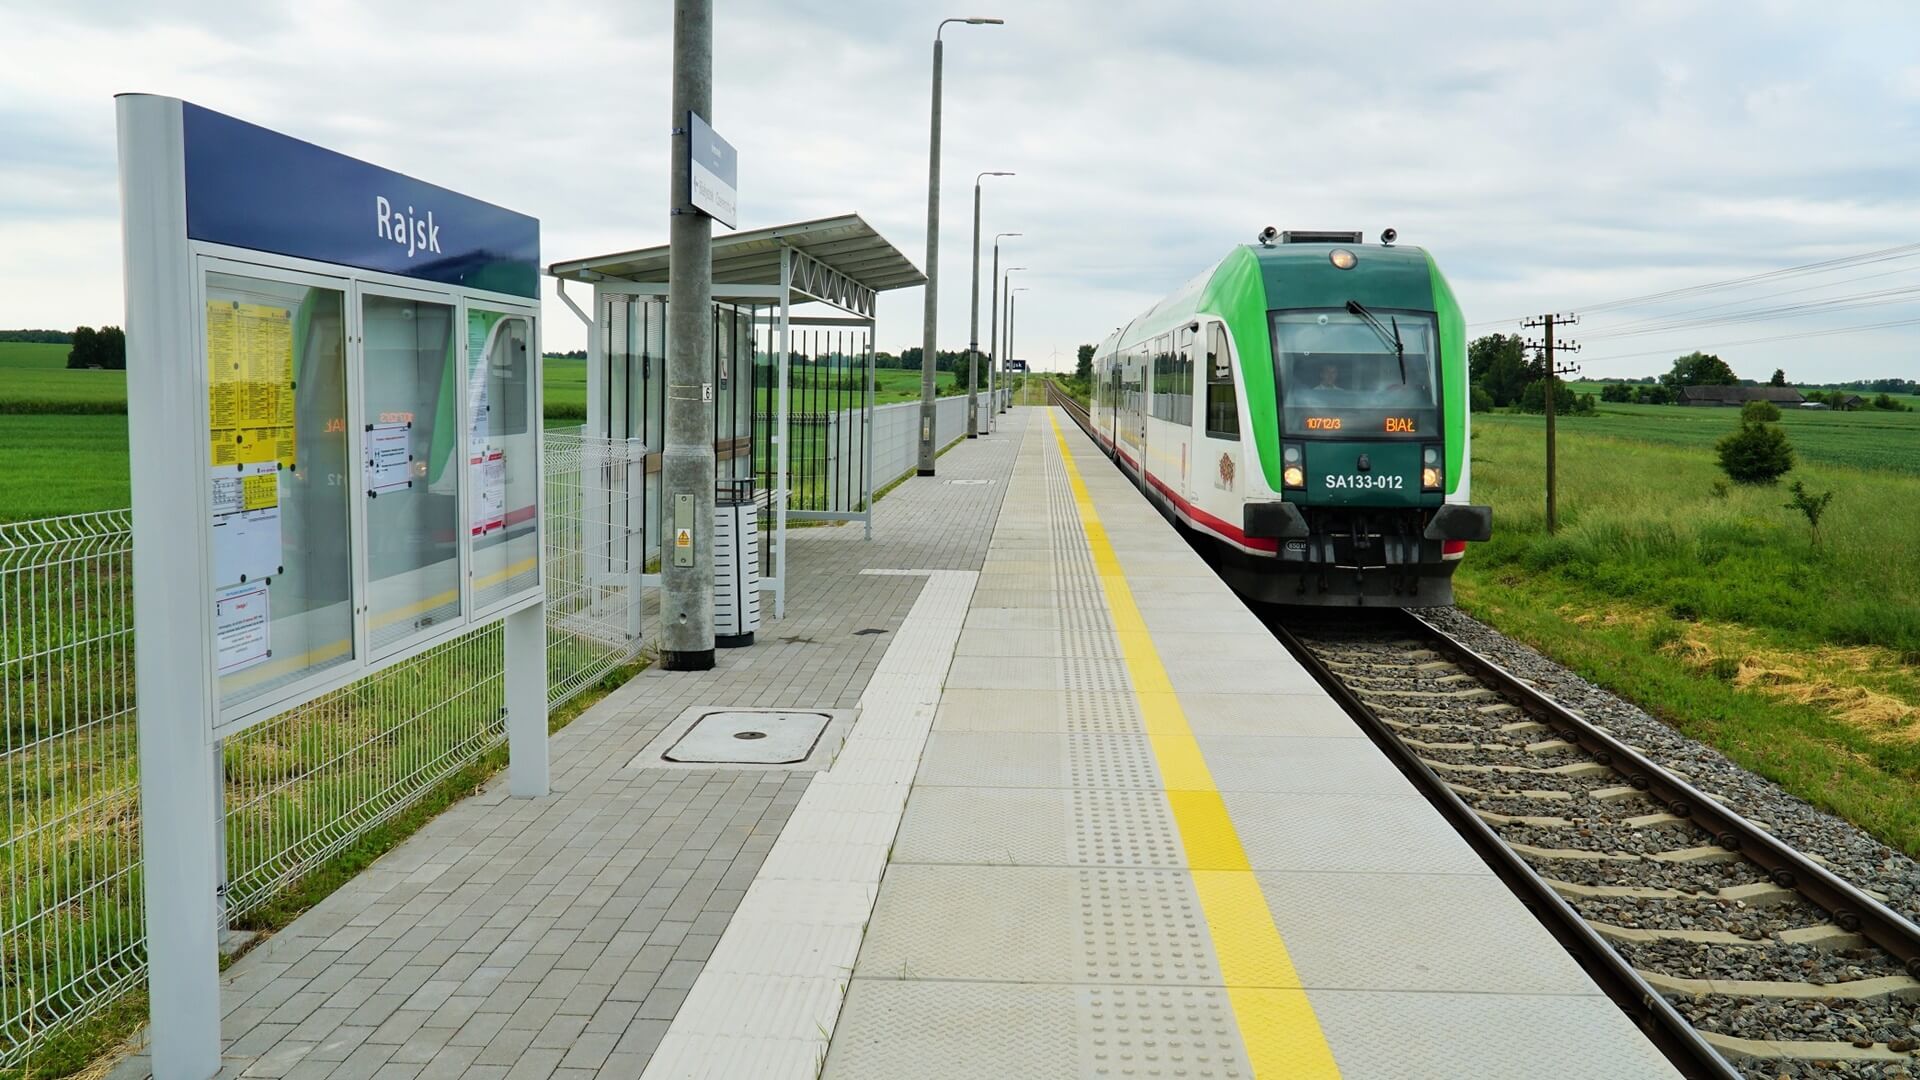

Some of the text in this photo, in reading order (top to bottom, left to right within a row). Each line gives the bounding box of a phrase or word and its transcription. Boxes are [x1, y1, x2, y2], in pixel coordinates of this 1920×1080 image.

[376, 195, 441, 257] Rajsk
[705, 387, 711, 399] 6
[1306, 417, 1416, 432] 10712/3 BIAŁ
[1325, 474, 1403, 489] SA133-012
